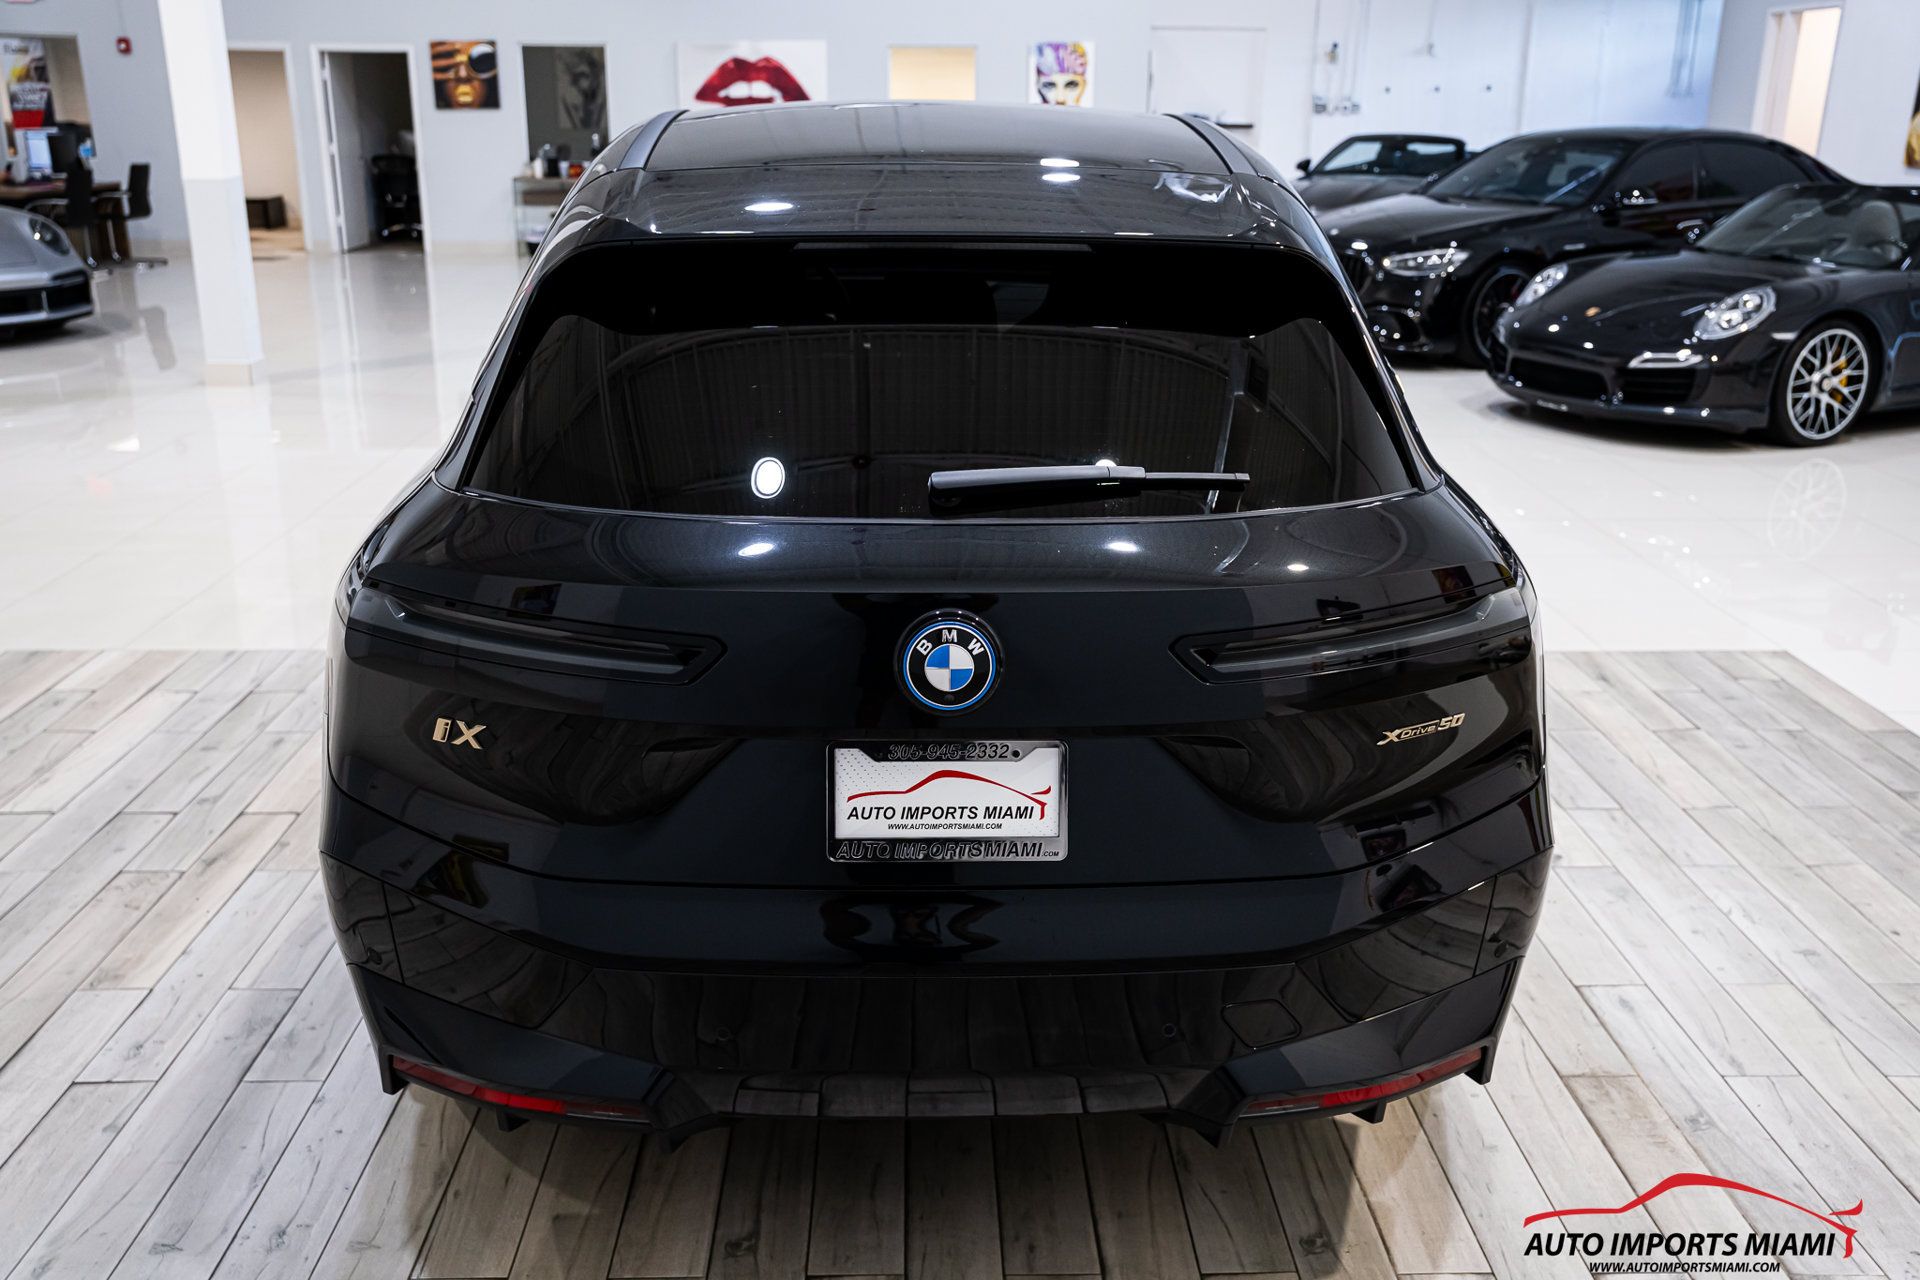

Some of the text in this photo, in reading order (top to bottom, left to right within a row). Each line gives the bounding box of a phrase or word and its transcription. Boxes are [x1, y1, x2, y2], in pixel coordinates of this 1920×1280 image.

[916, 629, 984, 656] BMW
[887, 743, 1010, 760] 305-945-2332
[847, 806, 1034, 820] AUTO IMPORTS MIAMI
[836, 841, 891, 859] AUTO
